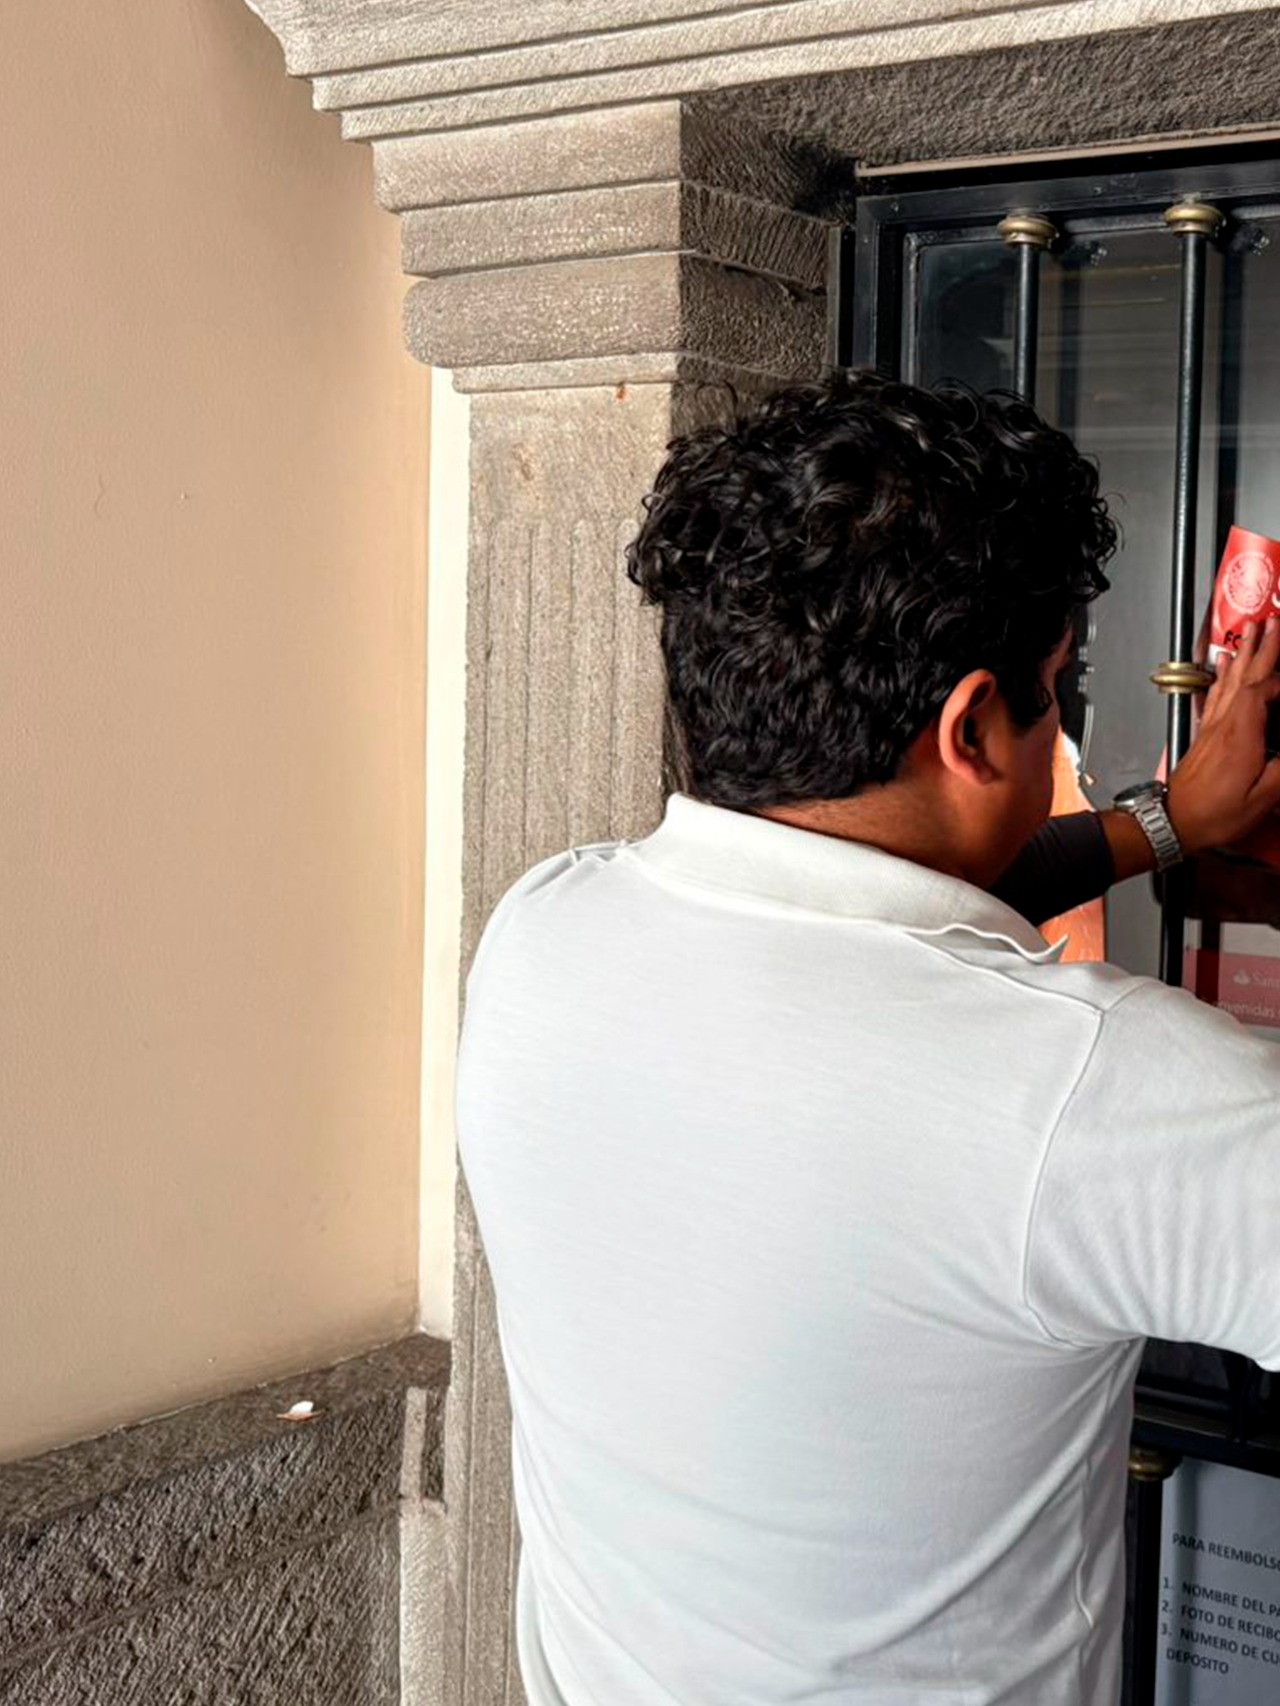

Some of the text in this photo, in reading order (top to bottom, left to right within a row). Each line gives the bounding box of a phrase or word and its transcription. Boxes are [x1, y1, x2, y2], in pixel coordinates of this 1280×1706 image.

[1172, 1533, 1205, 1551] PARA
[1182, 1581, 1238, 1607] NOMBRE
[1242, 1597, 1266, 1614] DEL
[1180, 1604, 1214, 1624] FOTO
[1217, 1615, 1235, 1630] DE
[1179, 1628, 1238, 1654] NUMERO
[1241, 1643, 1259, 1658] DE
[1165, 1647, 1230, 1675] DEPOSITO
